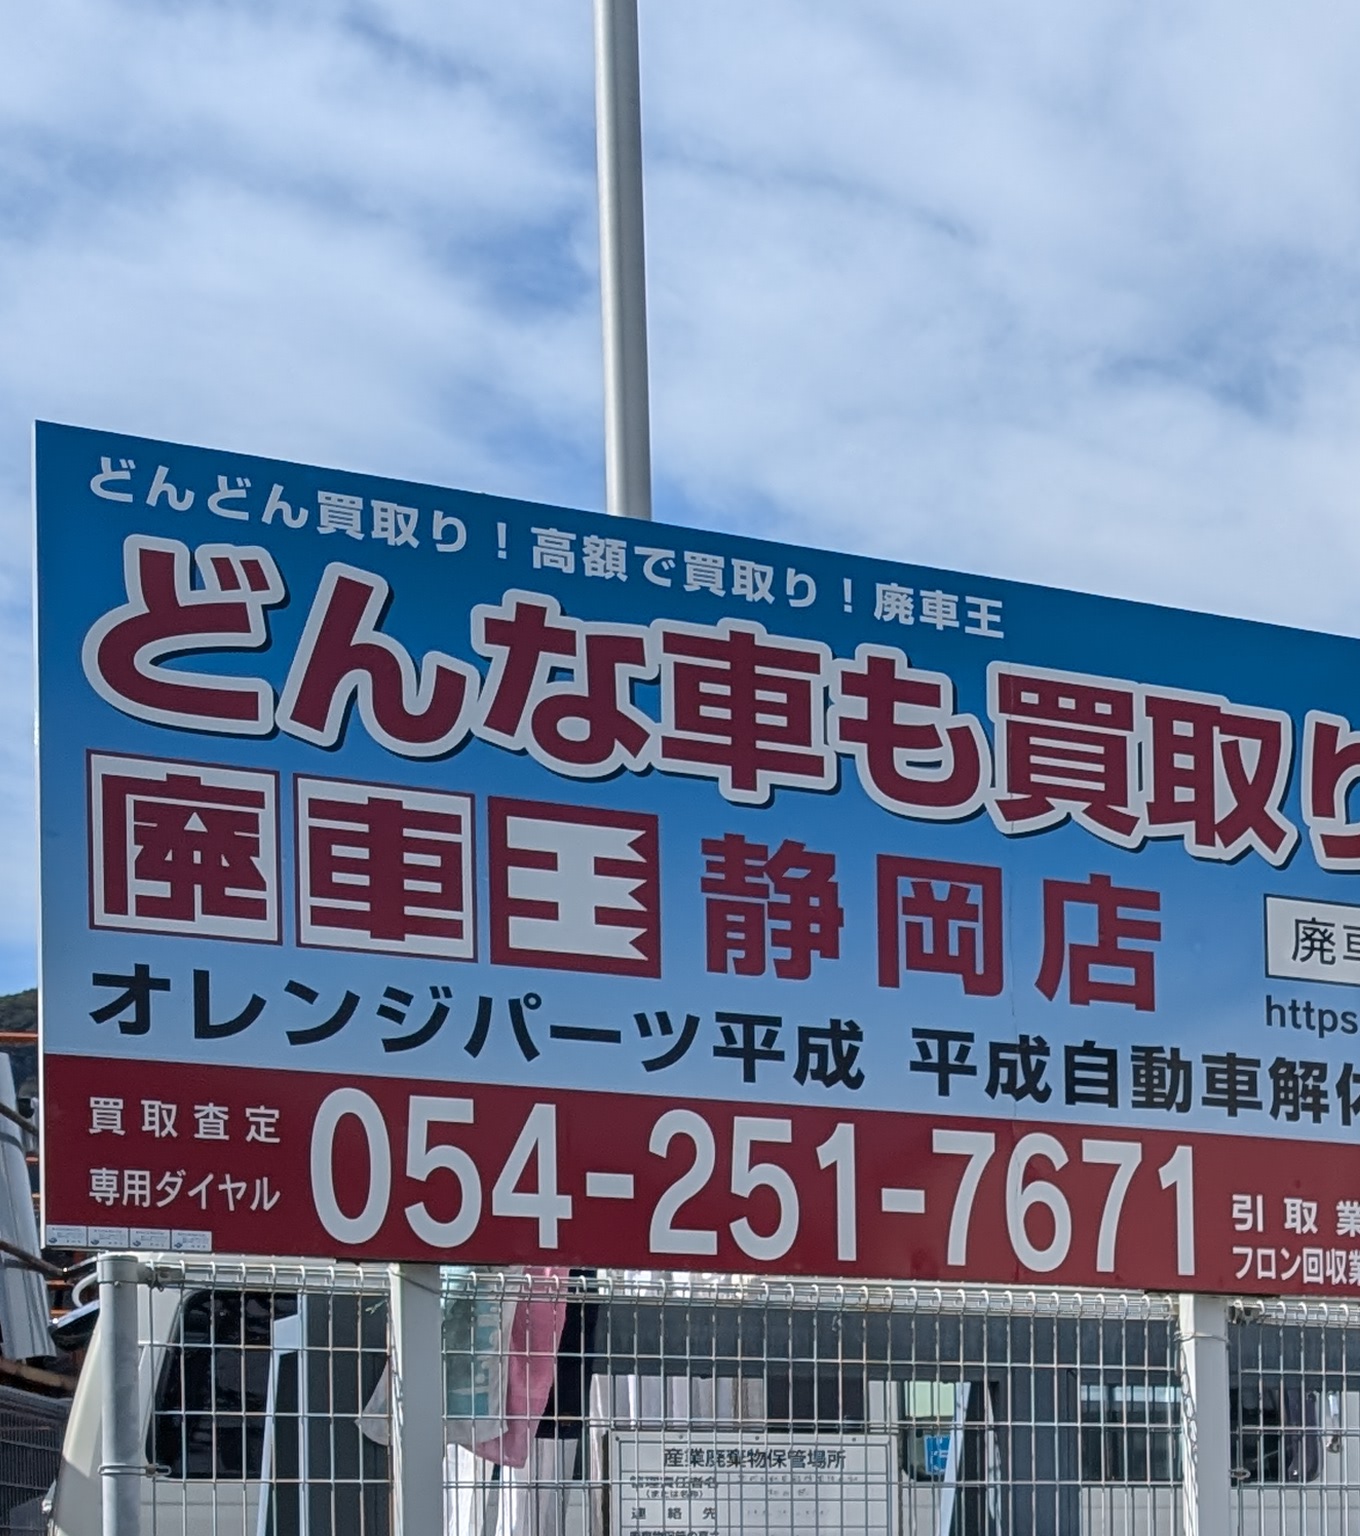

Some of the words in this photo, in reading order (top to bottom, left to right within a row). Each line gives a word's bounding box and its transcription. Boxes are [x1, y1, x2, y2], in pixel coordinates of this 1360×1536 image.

[89, 964, 865, 1092] オレンジパーツ平成
[88, 1097, 281, 1144] 買取査定
[88, 1167, 281, 1213] 専用ダイヤル
[310, 1087, 1197, 1276] 054-251-7671
[664, 1447, 847, 1470] 産業廃棄物保管場所
